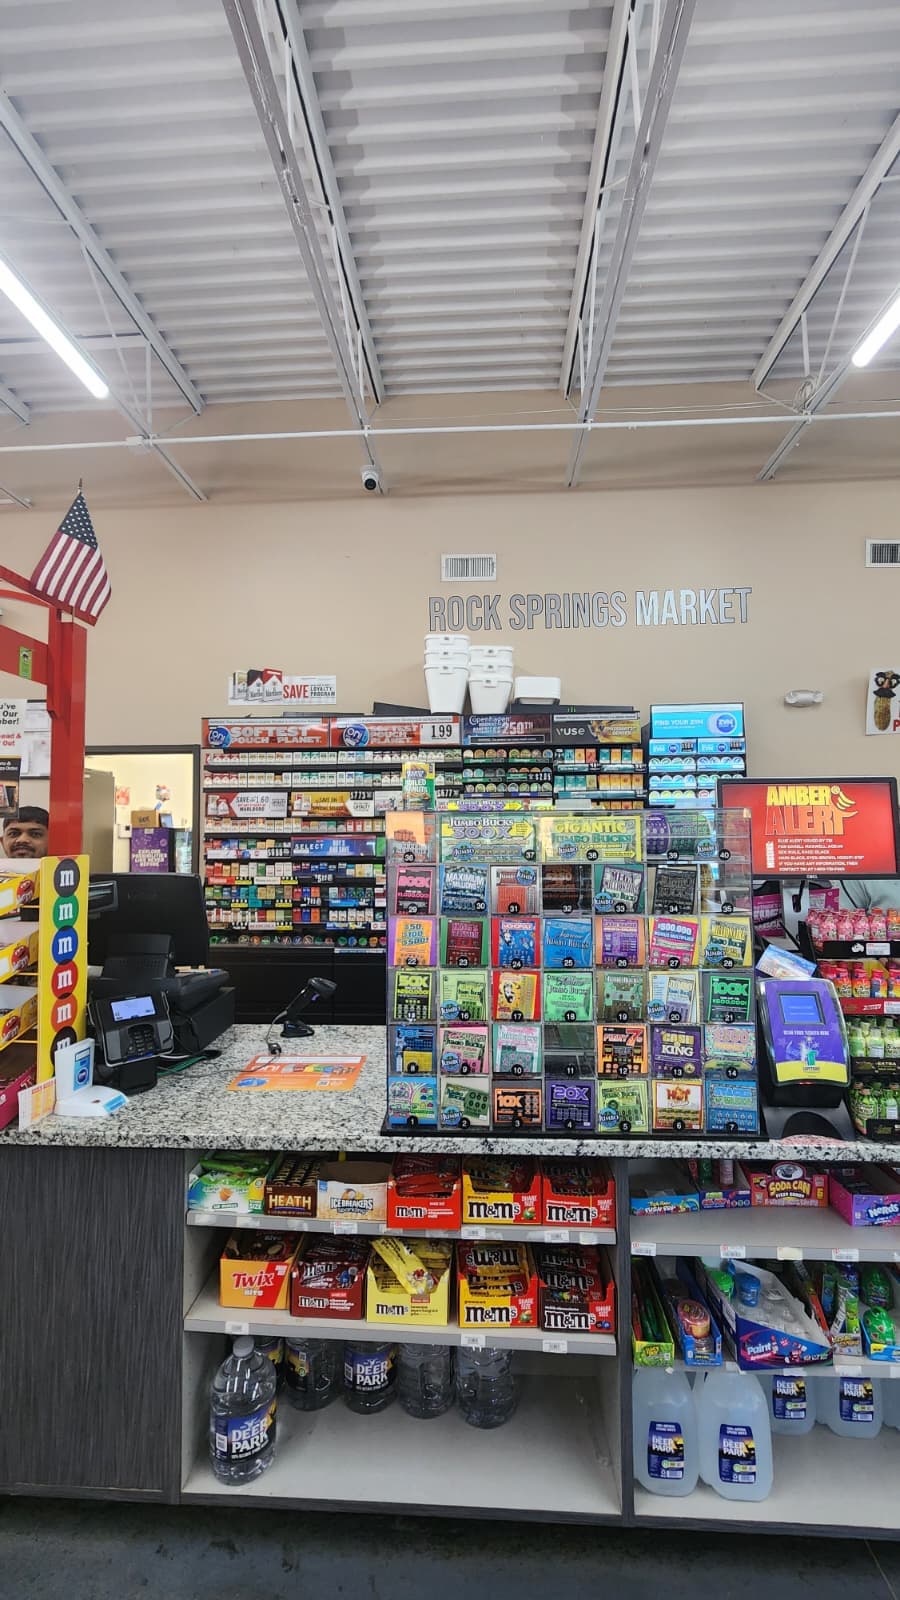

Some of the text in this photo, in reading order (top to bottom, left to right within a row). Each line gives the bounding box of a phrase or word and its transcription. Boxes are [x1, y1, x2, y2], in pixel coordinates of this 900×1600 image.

[428, 587, 752, 632] ROCK SPRINGS MARKET
[283, 684, 308, 698] SAVE
[231, 727, 310, 737] SOFTEST
[767, 786, 830, 806] AMBER
[450, 818, 514, 827] JUMBO BUCKS
[556, 822, 626, 833] GIGANTIC
[765, 806, 849, 836] ALERT
[454, 827, 512, 838] 300X
[60, 868, 75, 886] m
[445, 873, 484, 886] MAXIMUM
[58, 902, 74, 920] m
[58, 936, 72, 954] m
[58, 970, 72, 988] m
[713, 983, 748, 996] 100X
[57, 1003, 72, 1022] m
[662, 1034, 694, 1044] CASH
[662, 1046, 694, 1056] KING
[554, 1087, 589, 1100] 20X
[498, 1096, 522, 1108] 10X
[768, 1180, 811, 1196] SODA CAN
[269, 1194, 312, 1208] HEATH
[356, 1361, 388, 1376] DEER
[356, 1372, 388, 1386] PARK
[776, 1380, 796, 1390] DEER
[776, 1387, 798, 1396] PARK
[844, 1382, 864, 1392] DEER
[844, 1389, 864, 1398] PARK
[231, 1419, 269, 1442] DEER
[232, 1431, 268, 1454] PARK
[652, 1436, 674, 1446] DEER
[722, 1438, 744, 1449] DEER
[652, 1444, 675, 1454] PARK
[722, 1446, 746, 1457] PARK
